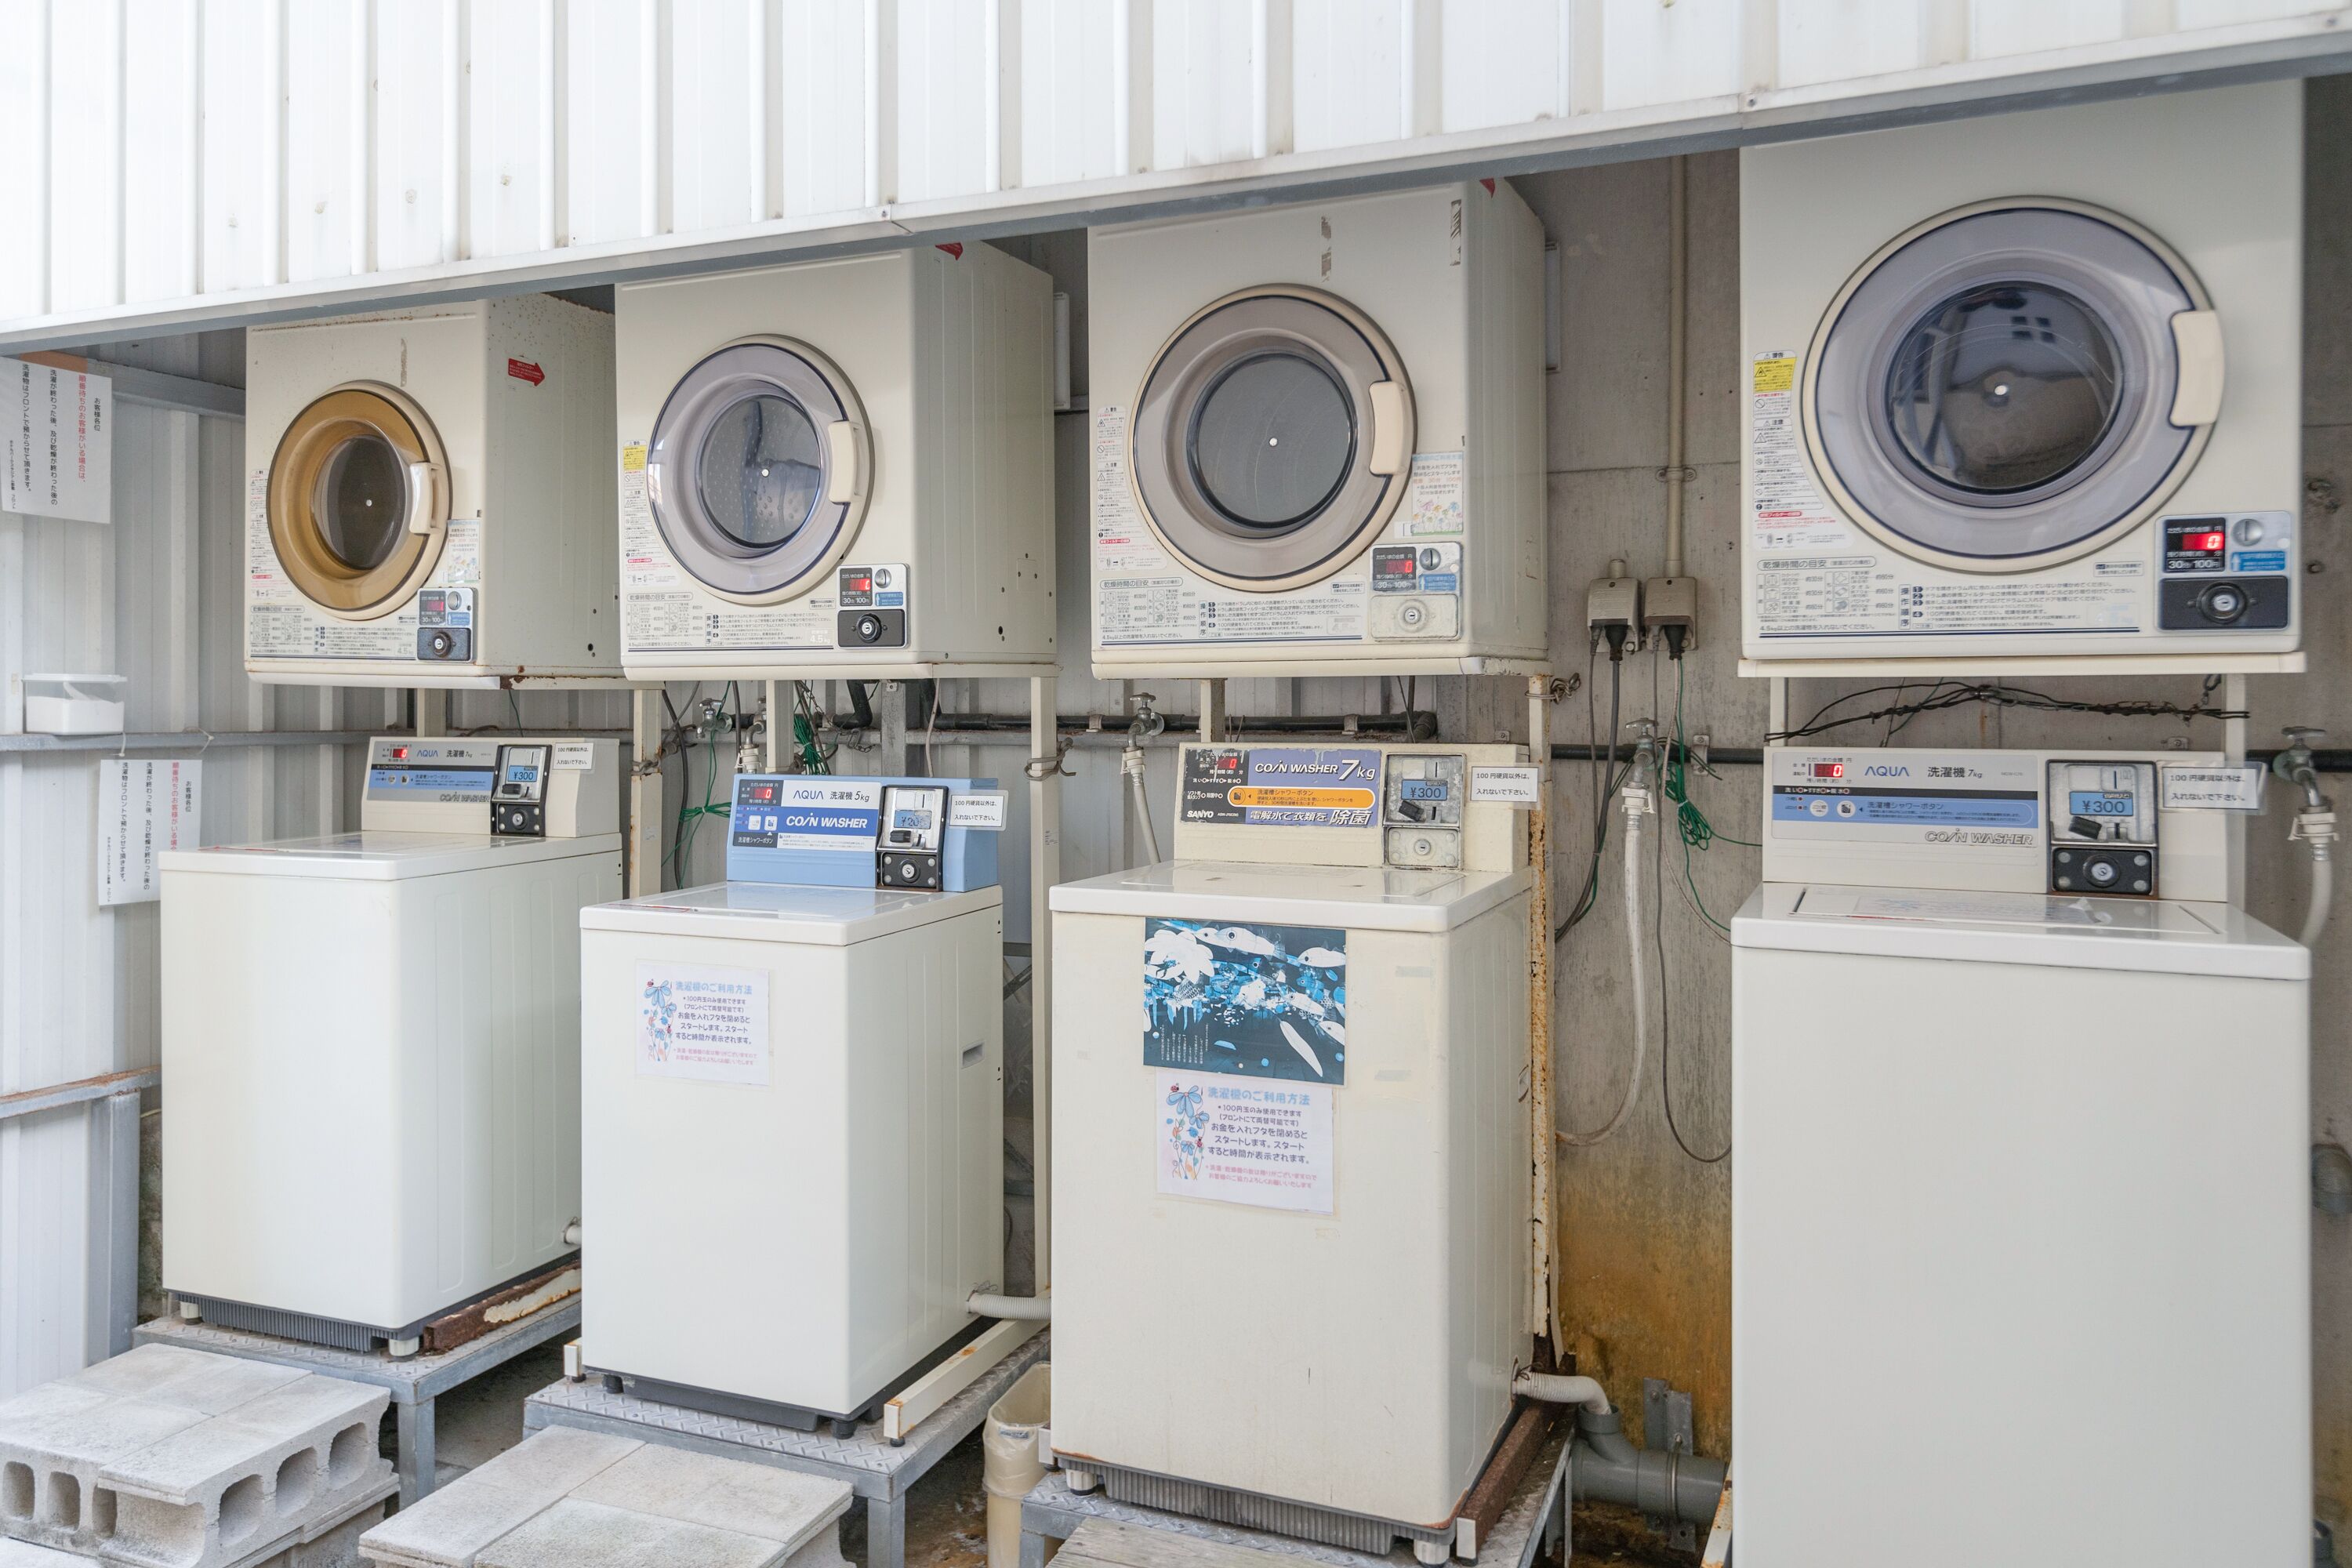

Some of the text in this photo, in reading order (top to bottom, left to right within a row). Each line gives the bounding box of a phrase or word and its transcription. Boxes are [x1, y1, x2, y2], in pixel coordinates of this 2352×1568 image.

[22, 364, 31, 492] 洗濯物はフロントで預からせて頂きます。
[2207, 535, 2221, 548] 0
[1404, 561, 1413, 573] 0
[1763, 559, 1827, 569] 乾燥時間の目安
[1104, 579, 1149, 588] 乾燥時間の目安
[1900, 587, 1909, 626] 操作順序
[401, 750, 407, 758] 0
[446, 750, 465, 758] 洗濯機
[1229, 758, 1238, 769] 0
[514, 771, 534, 780] ¥300
[1290, 763, 1339, 775] WASHER
[1339, 758, 1376, 782] 7kg
[1832, 764, 1842, 777] 0
[1864, 765, 1910, 777] AQUA
[1927, 766, 1965, 779] 洗濯機
[1968, 769, 1983, 779] 7kg
[2169, 774, 2245, 782] 100円硬貨以外は、
[765, 789, 772, 798] 0
[793, 789, 824, 800] AQUA
[829, 791, 869, 802] 洗濯機 5kg
[1410, 787, 1442, 798] ¥300
[2170, 793, 2245, 802] 入れないで下さい。
[1867, 801, 1944, 810] 洗濯槽シャワーボタン
[2082, 800, 2125, 813] ¥300
[1187, 810, 1214, 818] SANYO
[1250, 810, 1373, 826] 電解水で衣類を 除菌
[143, 762, 152, 891] 洗濯が終わった後、及び乾燥が終わった後の
[821, 817, 868, 829] WASHER
[1970, 832, 2033, 845] WASHER
[676, 981, 753, 995] 洗濯機のご利用方法
[687, 996, 746, 1005] 100円玉のみ使用できます
[677, 1012, 750, 1024] お金を入れフタを閉めると
[681, 1023, 748, 1033] スタートします。スタート
[675, 1033, 752, 1044] すると時間が表示されます。
[1207, 1087, 1310, 1105] 洗濯機のご利用方法
[1222, 1105, 1302, 1117] 100円玉のみ使用できます
[1211, 1123, 1308, 1139] お金を入れフタを閉めると
[1214, 1135, 1305, 1151] スタートします。スタート
[1208, 1147, 1309, 1164] すると時間が表示されます。
